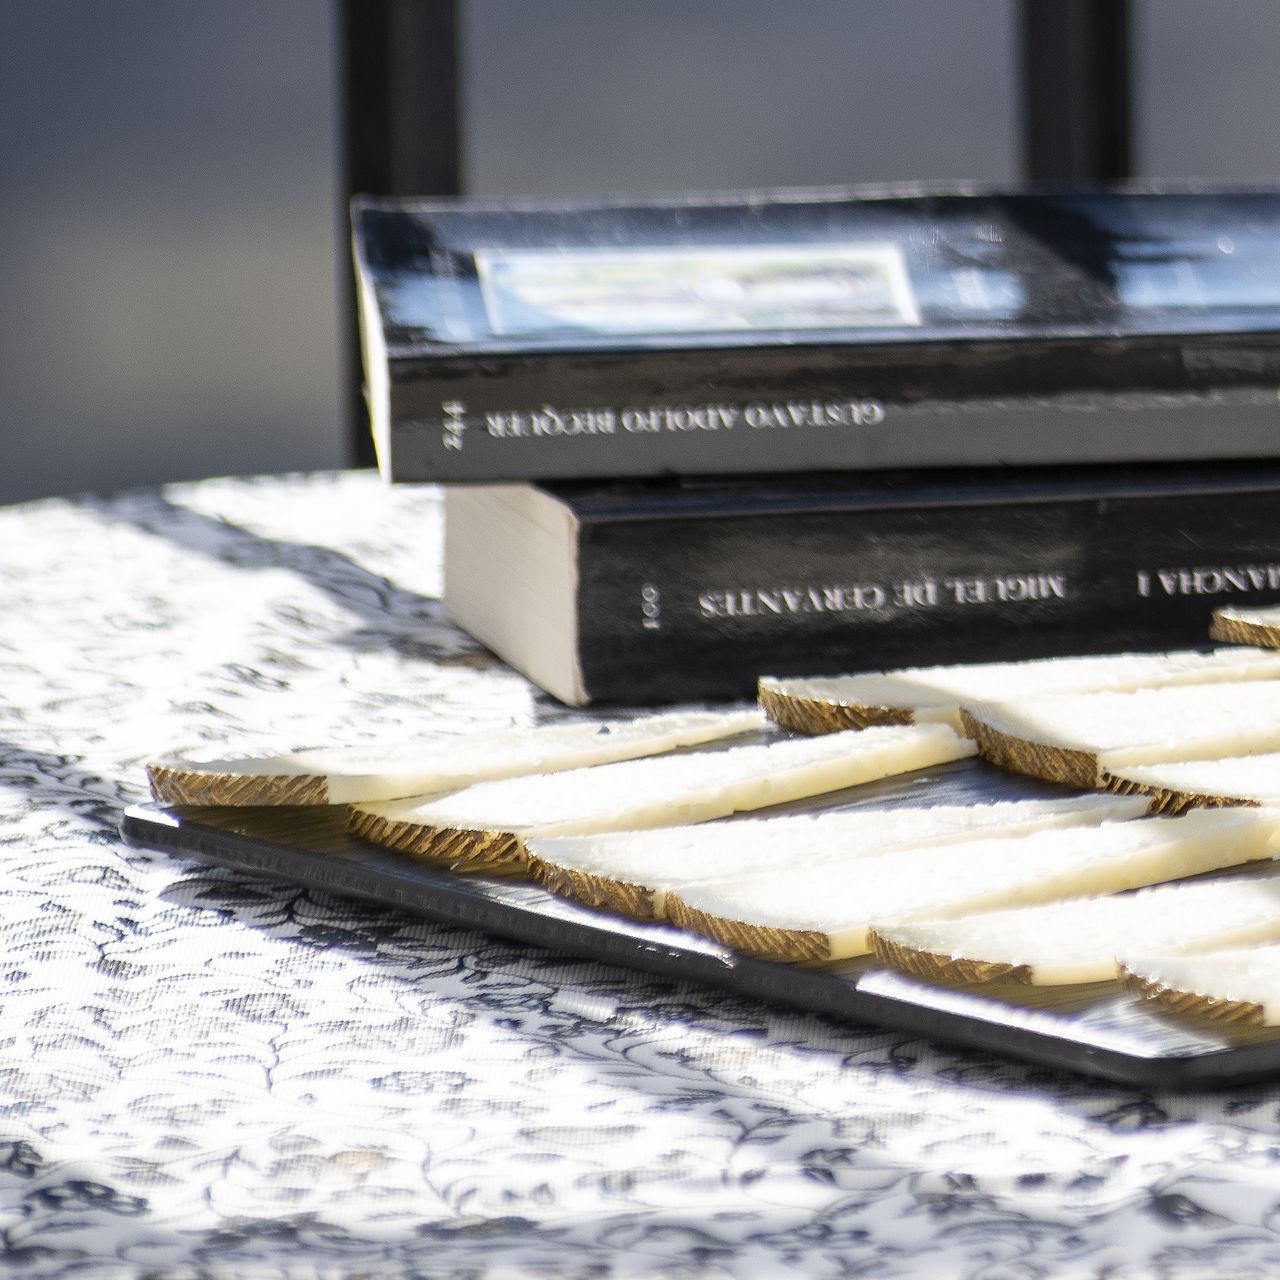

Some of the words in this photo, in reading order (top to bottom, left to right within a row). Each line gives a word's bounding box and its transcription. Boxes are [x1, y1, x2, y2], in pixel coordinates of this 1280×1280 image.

[621, 404, 740, 434] ADOLFO
[743, 398, 886, 429] GUSTAVO
[893, 577, 939, 608] DE
[944, 573, 1067, 605] MIGUEL
[1136, 568, 1152, 598] I
[641, 582, 661, 629] 100
[699, 583, 887, 618] CERVANTES
